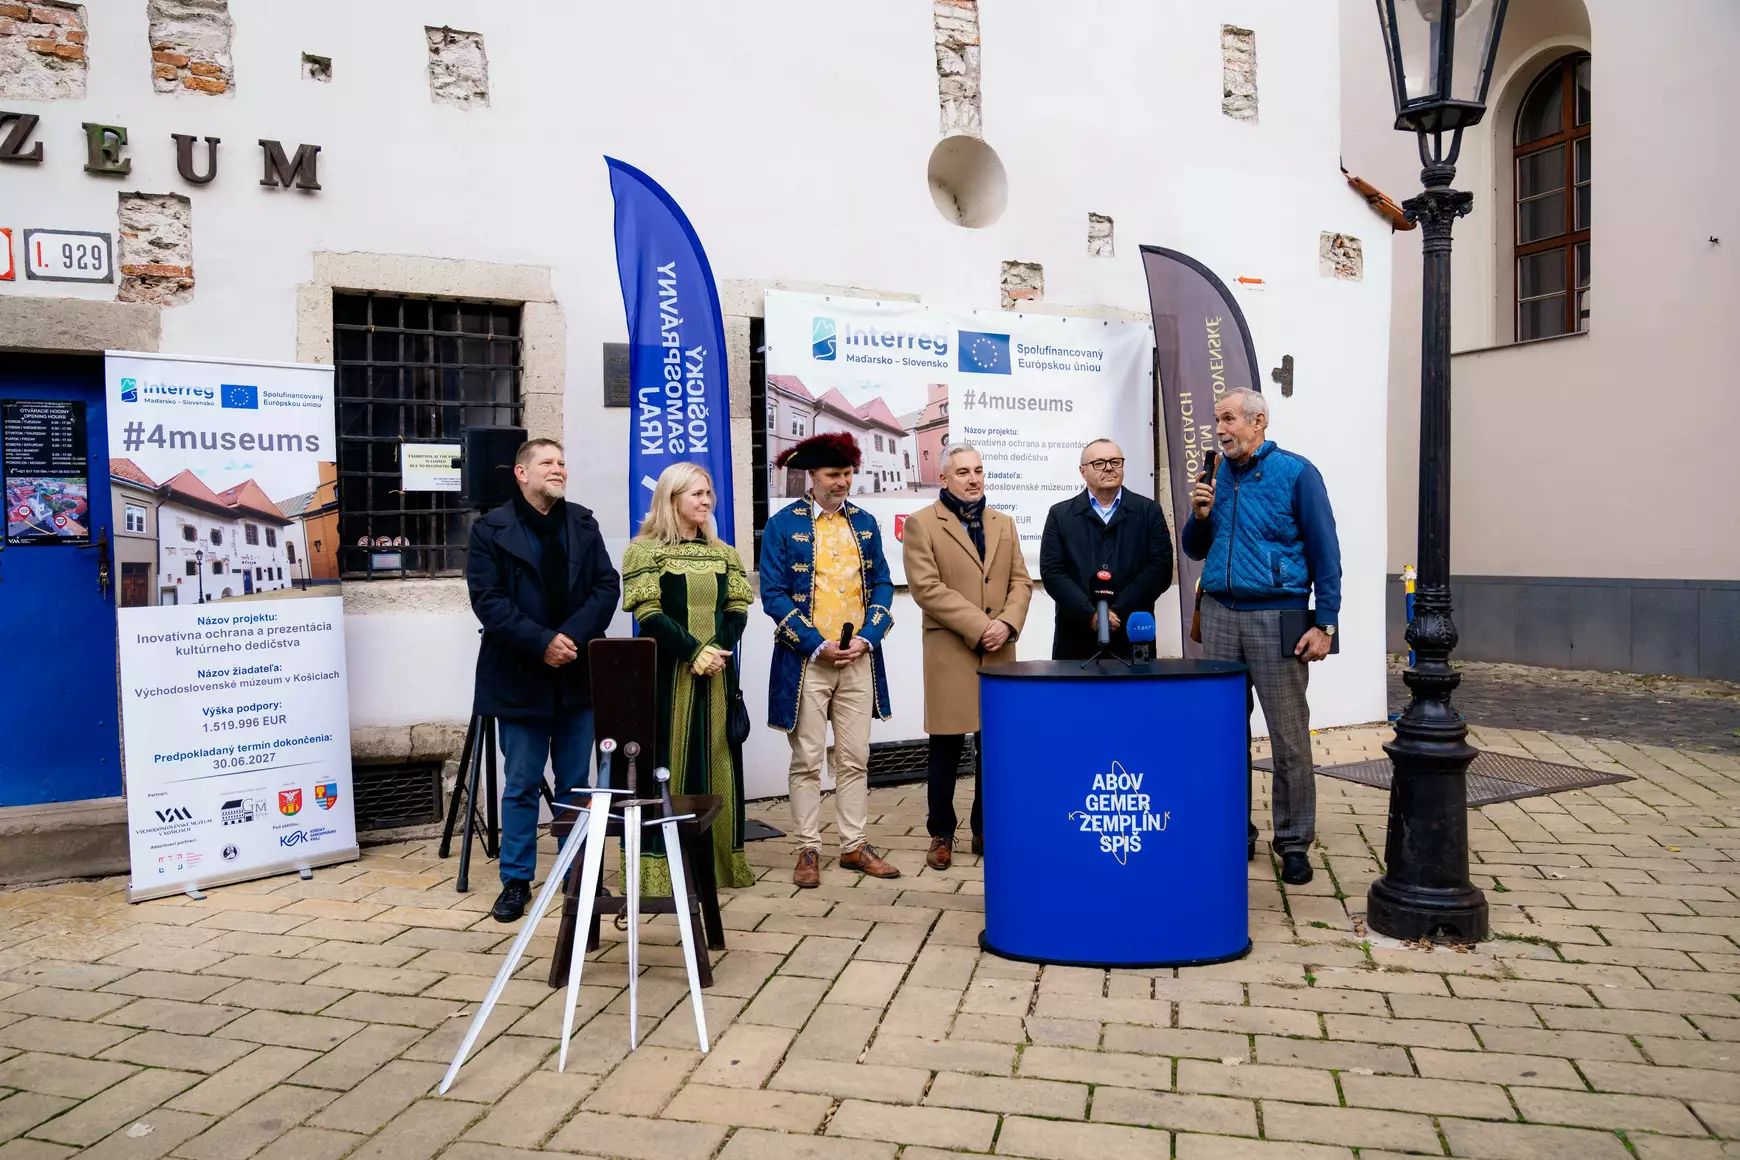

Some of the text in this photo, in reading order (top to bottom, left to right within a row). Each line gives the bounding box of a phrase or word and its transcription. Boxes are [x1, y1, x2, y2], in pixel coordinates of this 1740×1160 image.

[62, 243, 102, 270] 929
[845, 323, 948, 356] Interreg
[1016, 343, 1104, 359] Spolufinancovaný
[846, 354, 893, 365] Maďarsko
[902, 357, 949, 368] Slovensko
[1017, 358, 1101, 372] Európskou úniou
[144, 381, 215, 399] Interreg
[262, 390, 324, 402] Spolufinancovaný
[263, 399, 301, 408] Európskou
[963, 388, 1074, 413] #4museums
[123, 421, 320, 452] #4museums
[964, 426, 1019, 436] Názov projektu:
[1008, 439, 1040, 448] ochrana
[1010, 453, 1049, 462] dedičstva
[987, 471, 1023, 479] žiadateľa:
[1040, 482, 1073, 491] múzeum
[1015, 516, 1032, 524] EUR
[197, 613, 278, 626] Názov projektu:
[137, 632, 202, 644] Inovatívna
[205, 627, 254, 639] ochrana
[267, 622, 332, 636] prezentácia
[176, 637, 300, 656] kultúrneho dedičstva
[197, 663, 283, 678] Názov žiadateľa:
[134, 670, 340, 699] Východoslovenské múzeum v Košiciach
[202, 701, 282, 718] Výška podpory:
[202, 714, 287, 733] 1.519.996 EUR
[154, 734, 333, 763] Predpokladaný termín dokončenia:
[212, 752, 276, 770] 30.06.2027
[1092, 773, 1144, 790] ABOV
[1085, 794, 1151, 812] GEMER
[1080, 810, 1161, 832] ZEMPLÍN
[1099, 831, 1142, 853] SPIŠ
